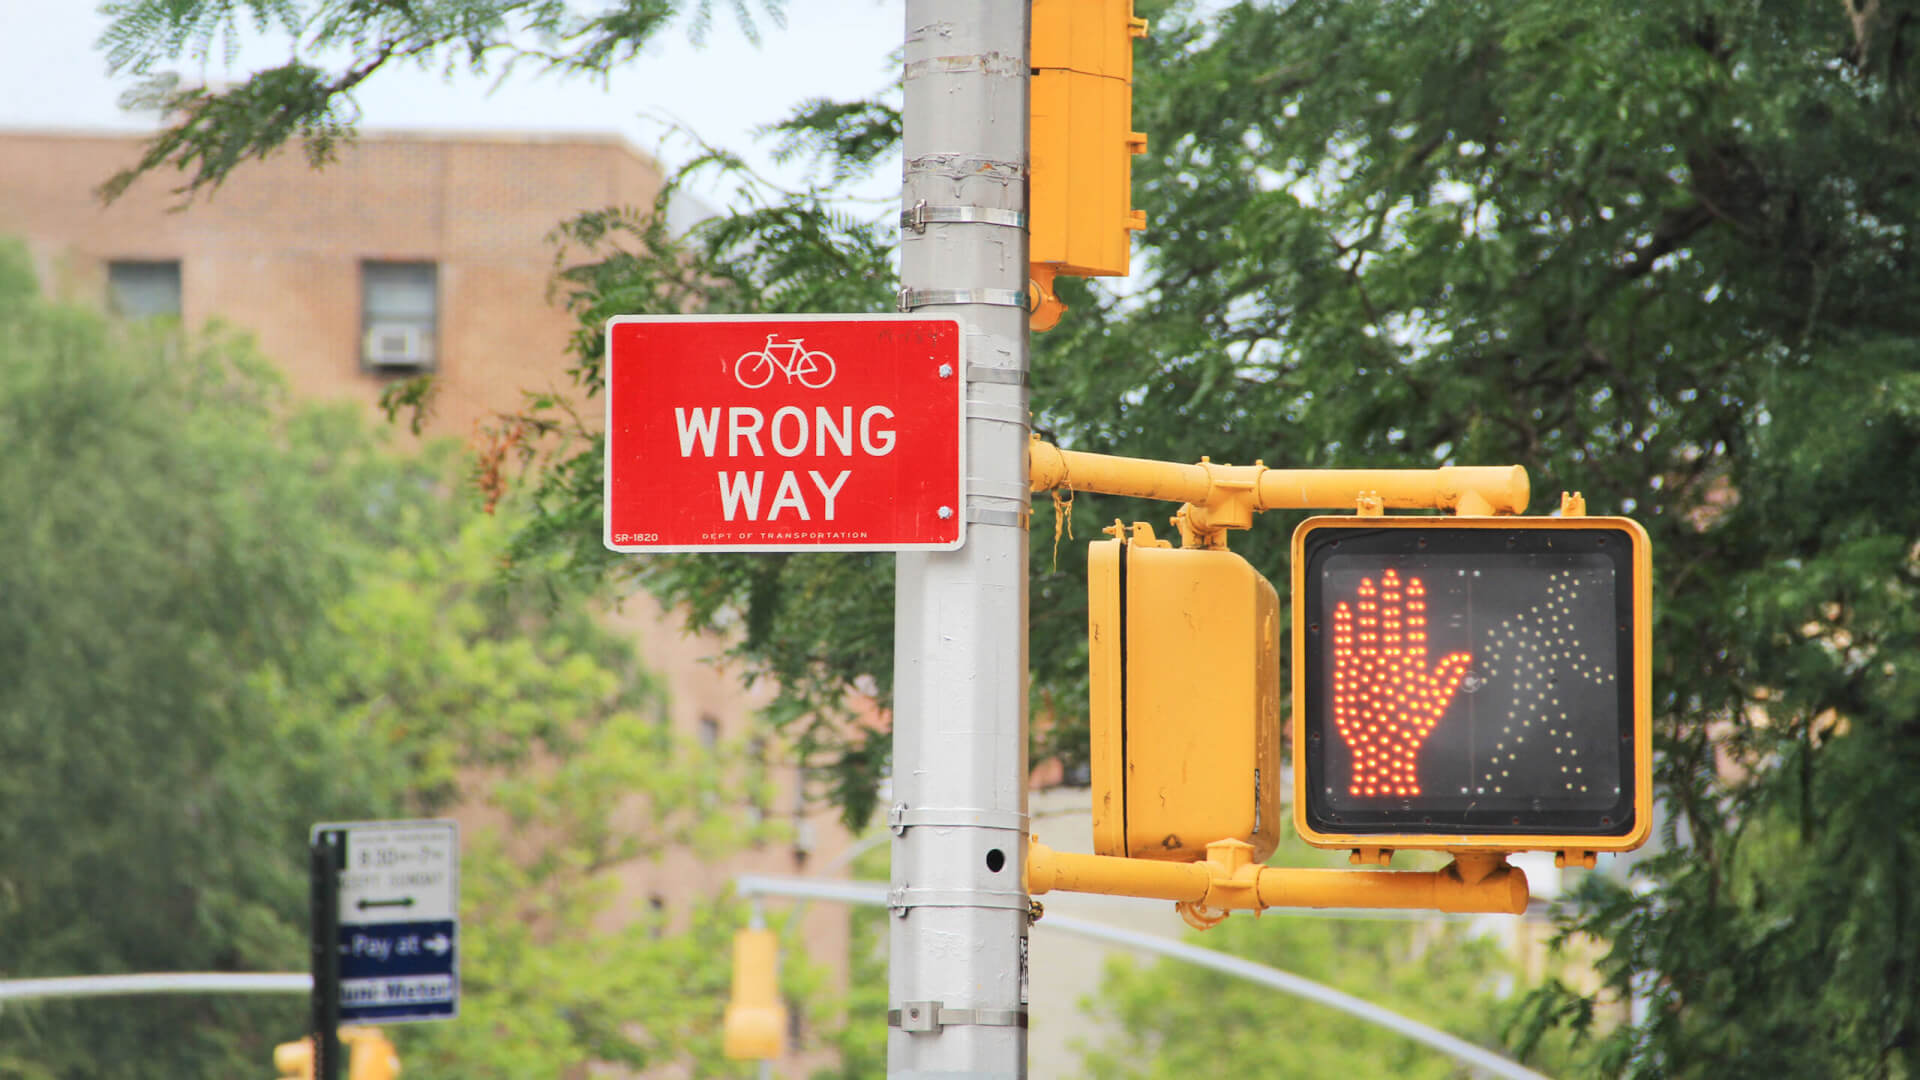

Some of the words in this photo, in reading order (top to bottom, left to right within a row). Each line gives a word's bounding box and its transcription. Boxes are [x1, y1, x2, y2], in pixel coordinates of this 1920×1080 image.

[675, 405, 897, 458] WRONG
[717, 470, 852, 522] WAY
[614, 532, 659, 543] SR-1820
[701, 532, 732, 541] DEPT
[738, 532, 753, 540] OF
[759, 531, 868, 540] TRANSPORTATION
[352, 933, 392, 962] Pay
[395, 934, 420, 955] at
